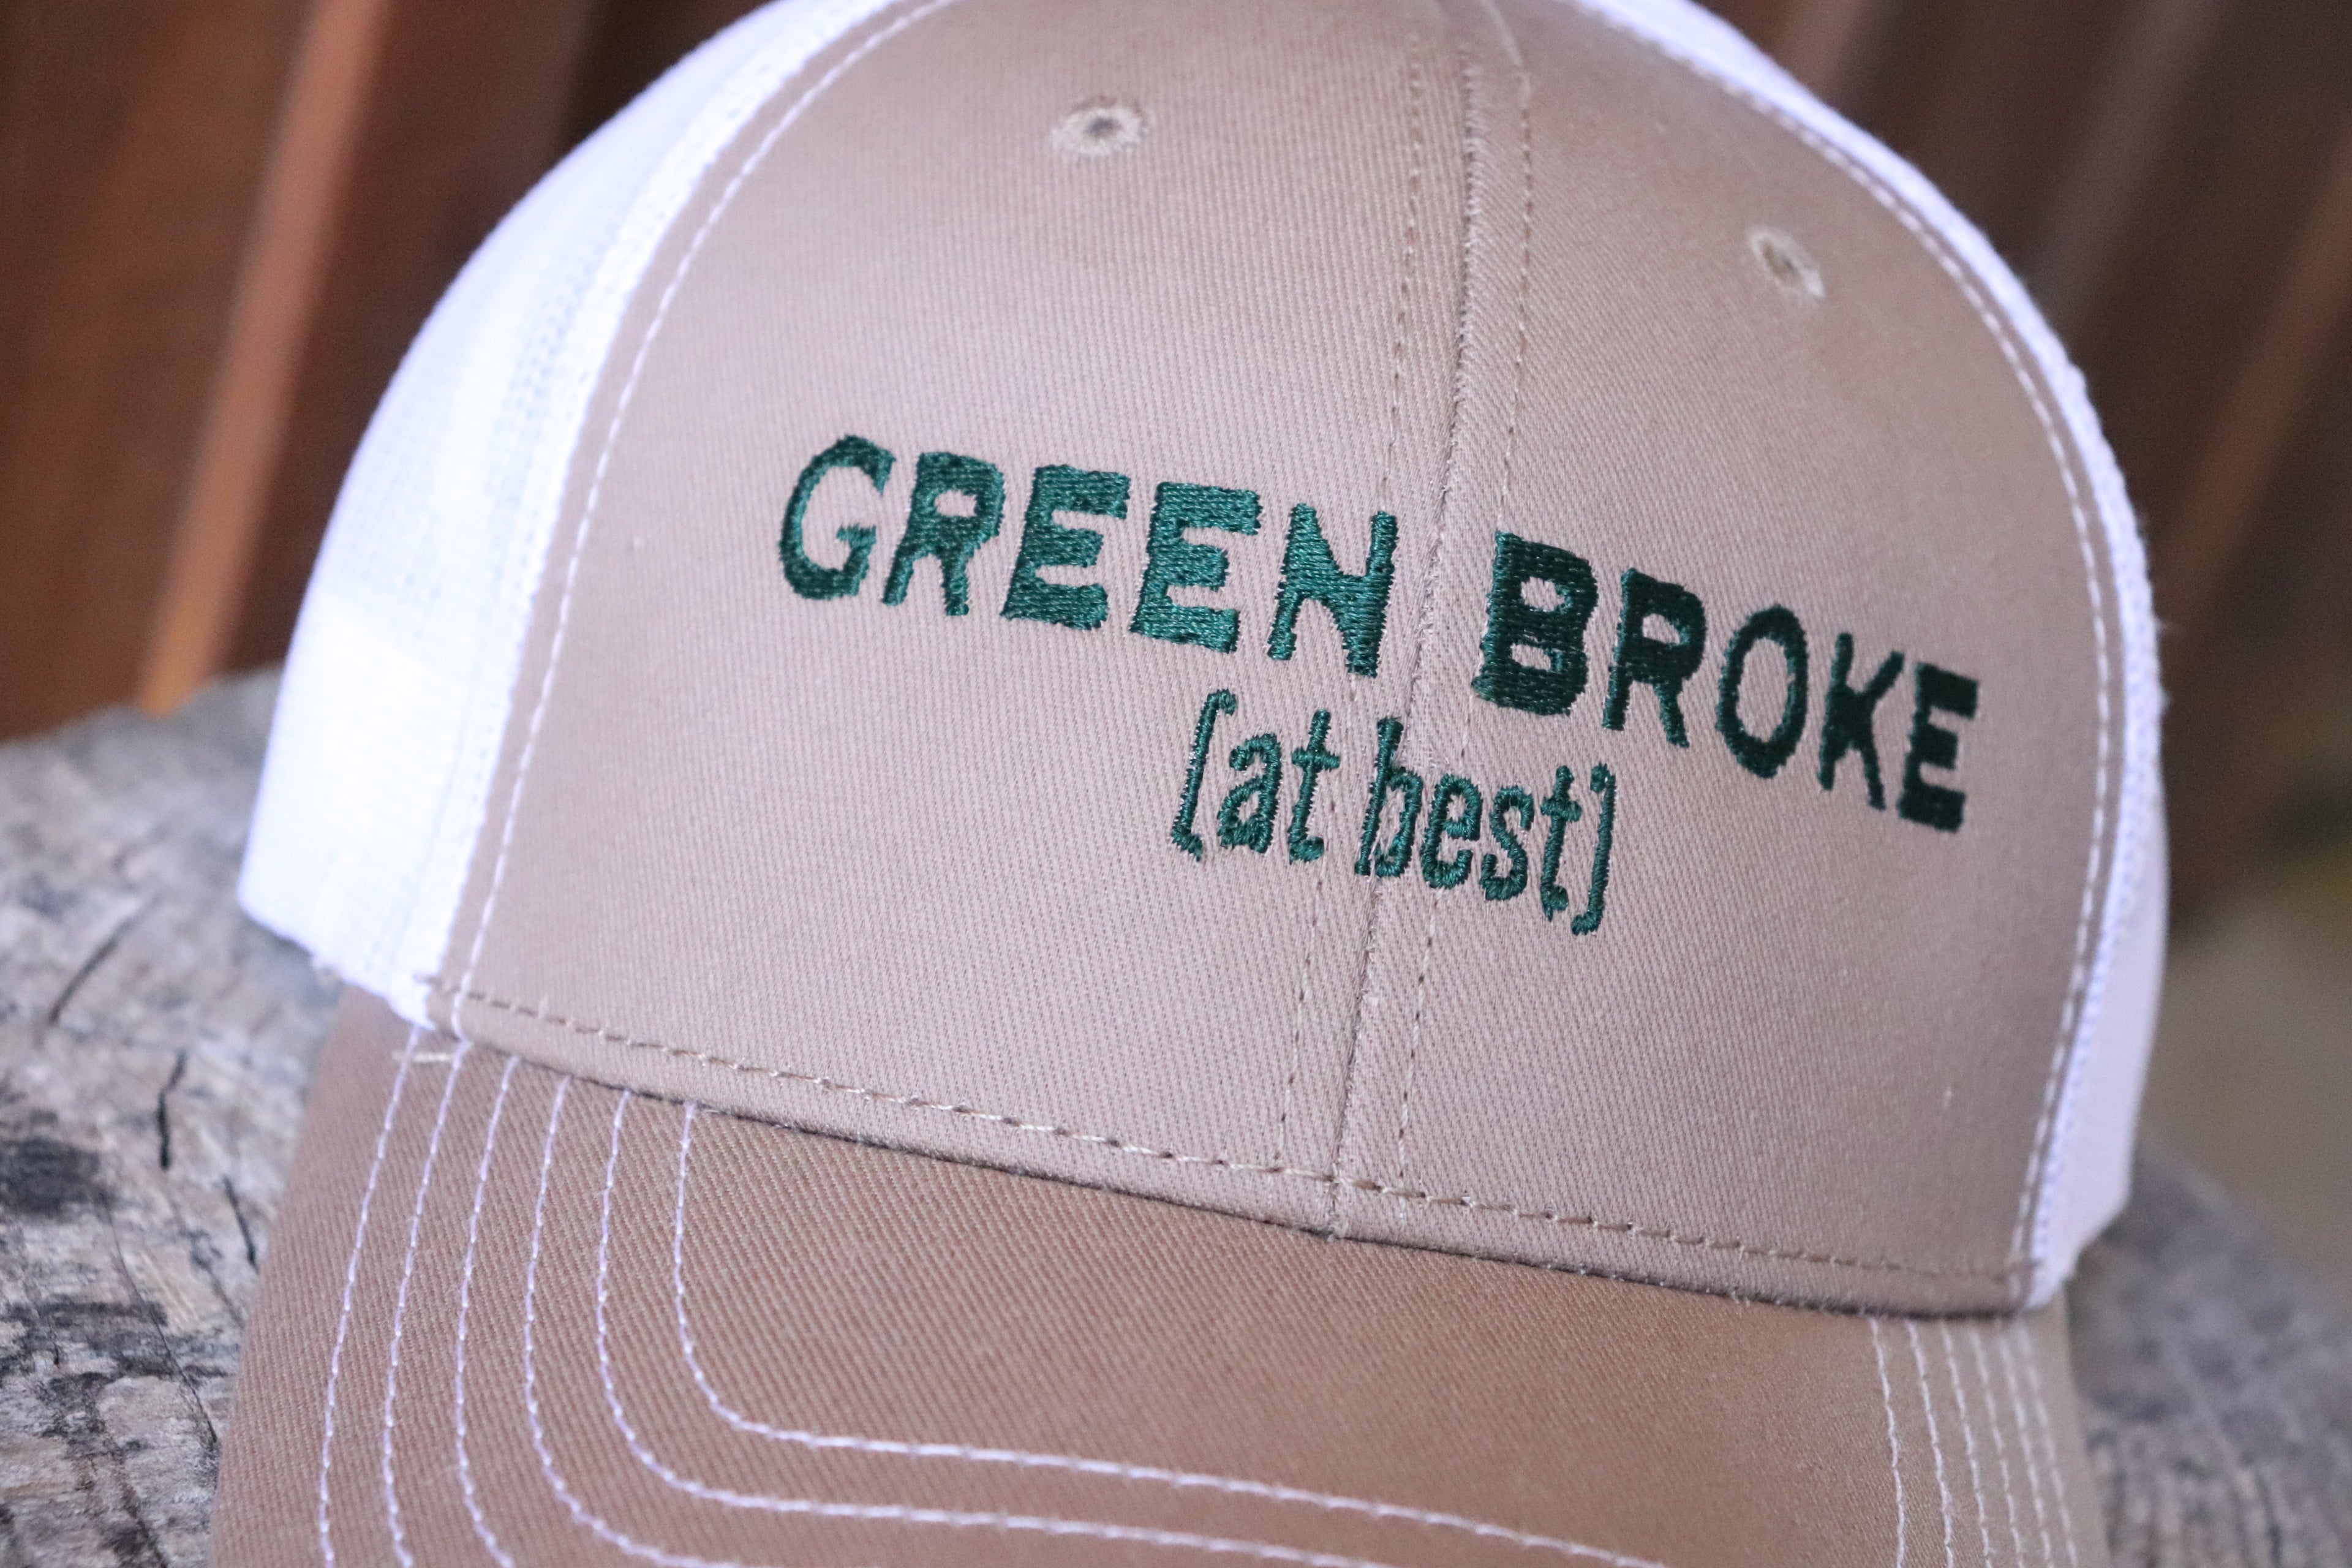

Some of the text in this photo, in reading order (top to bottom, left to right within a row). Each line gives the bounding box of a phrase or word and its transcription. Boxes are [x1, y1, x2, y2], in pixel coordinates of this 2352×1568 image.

[778, 434, 1979, 832] GREEN BROKE
[1170, 688, 1617, 935] [at best]
